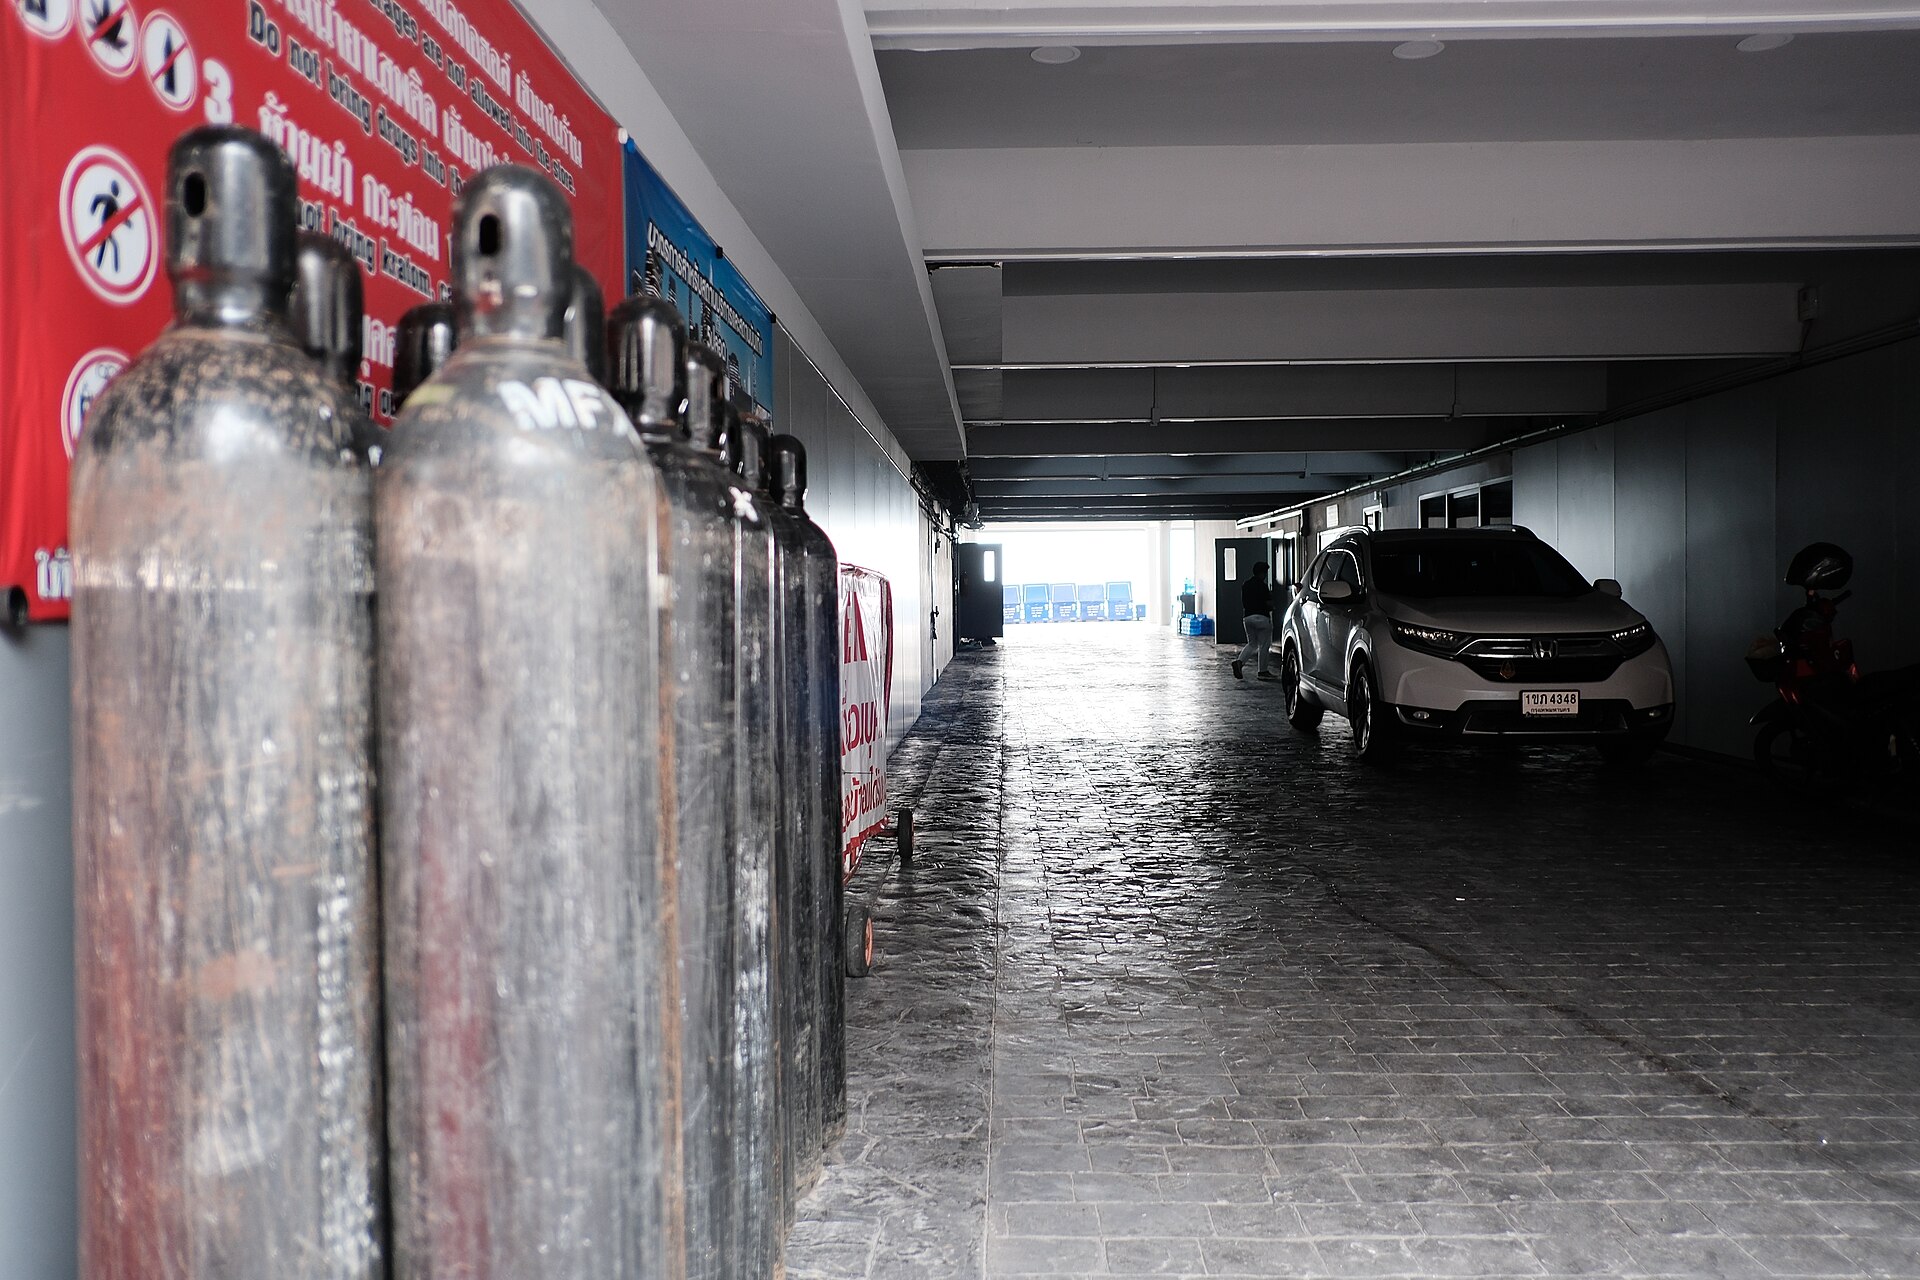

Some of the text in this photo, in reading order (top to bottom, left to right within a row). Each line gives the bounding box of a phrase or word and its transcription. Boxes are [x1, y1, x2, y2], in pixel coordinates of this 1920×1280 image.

[247, 0, 281, 57] Do
[287, 35, 322, 90] not
[325, 57, 372, 136] bring
[376, 103, 419, 167] drugs
[421, 138, 447, 188] into
[421, 30, 443, 71] are
[445, 53, 467, 95] not
[470, 77, 513, 138] allowed
[513, 115, 533, 157] into
[535, 138, 551, 173] the
[362, 173, 440, 260] กระท่อม
[1549, 693, 1577, 705] 4348
